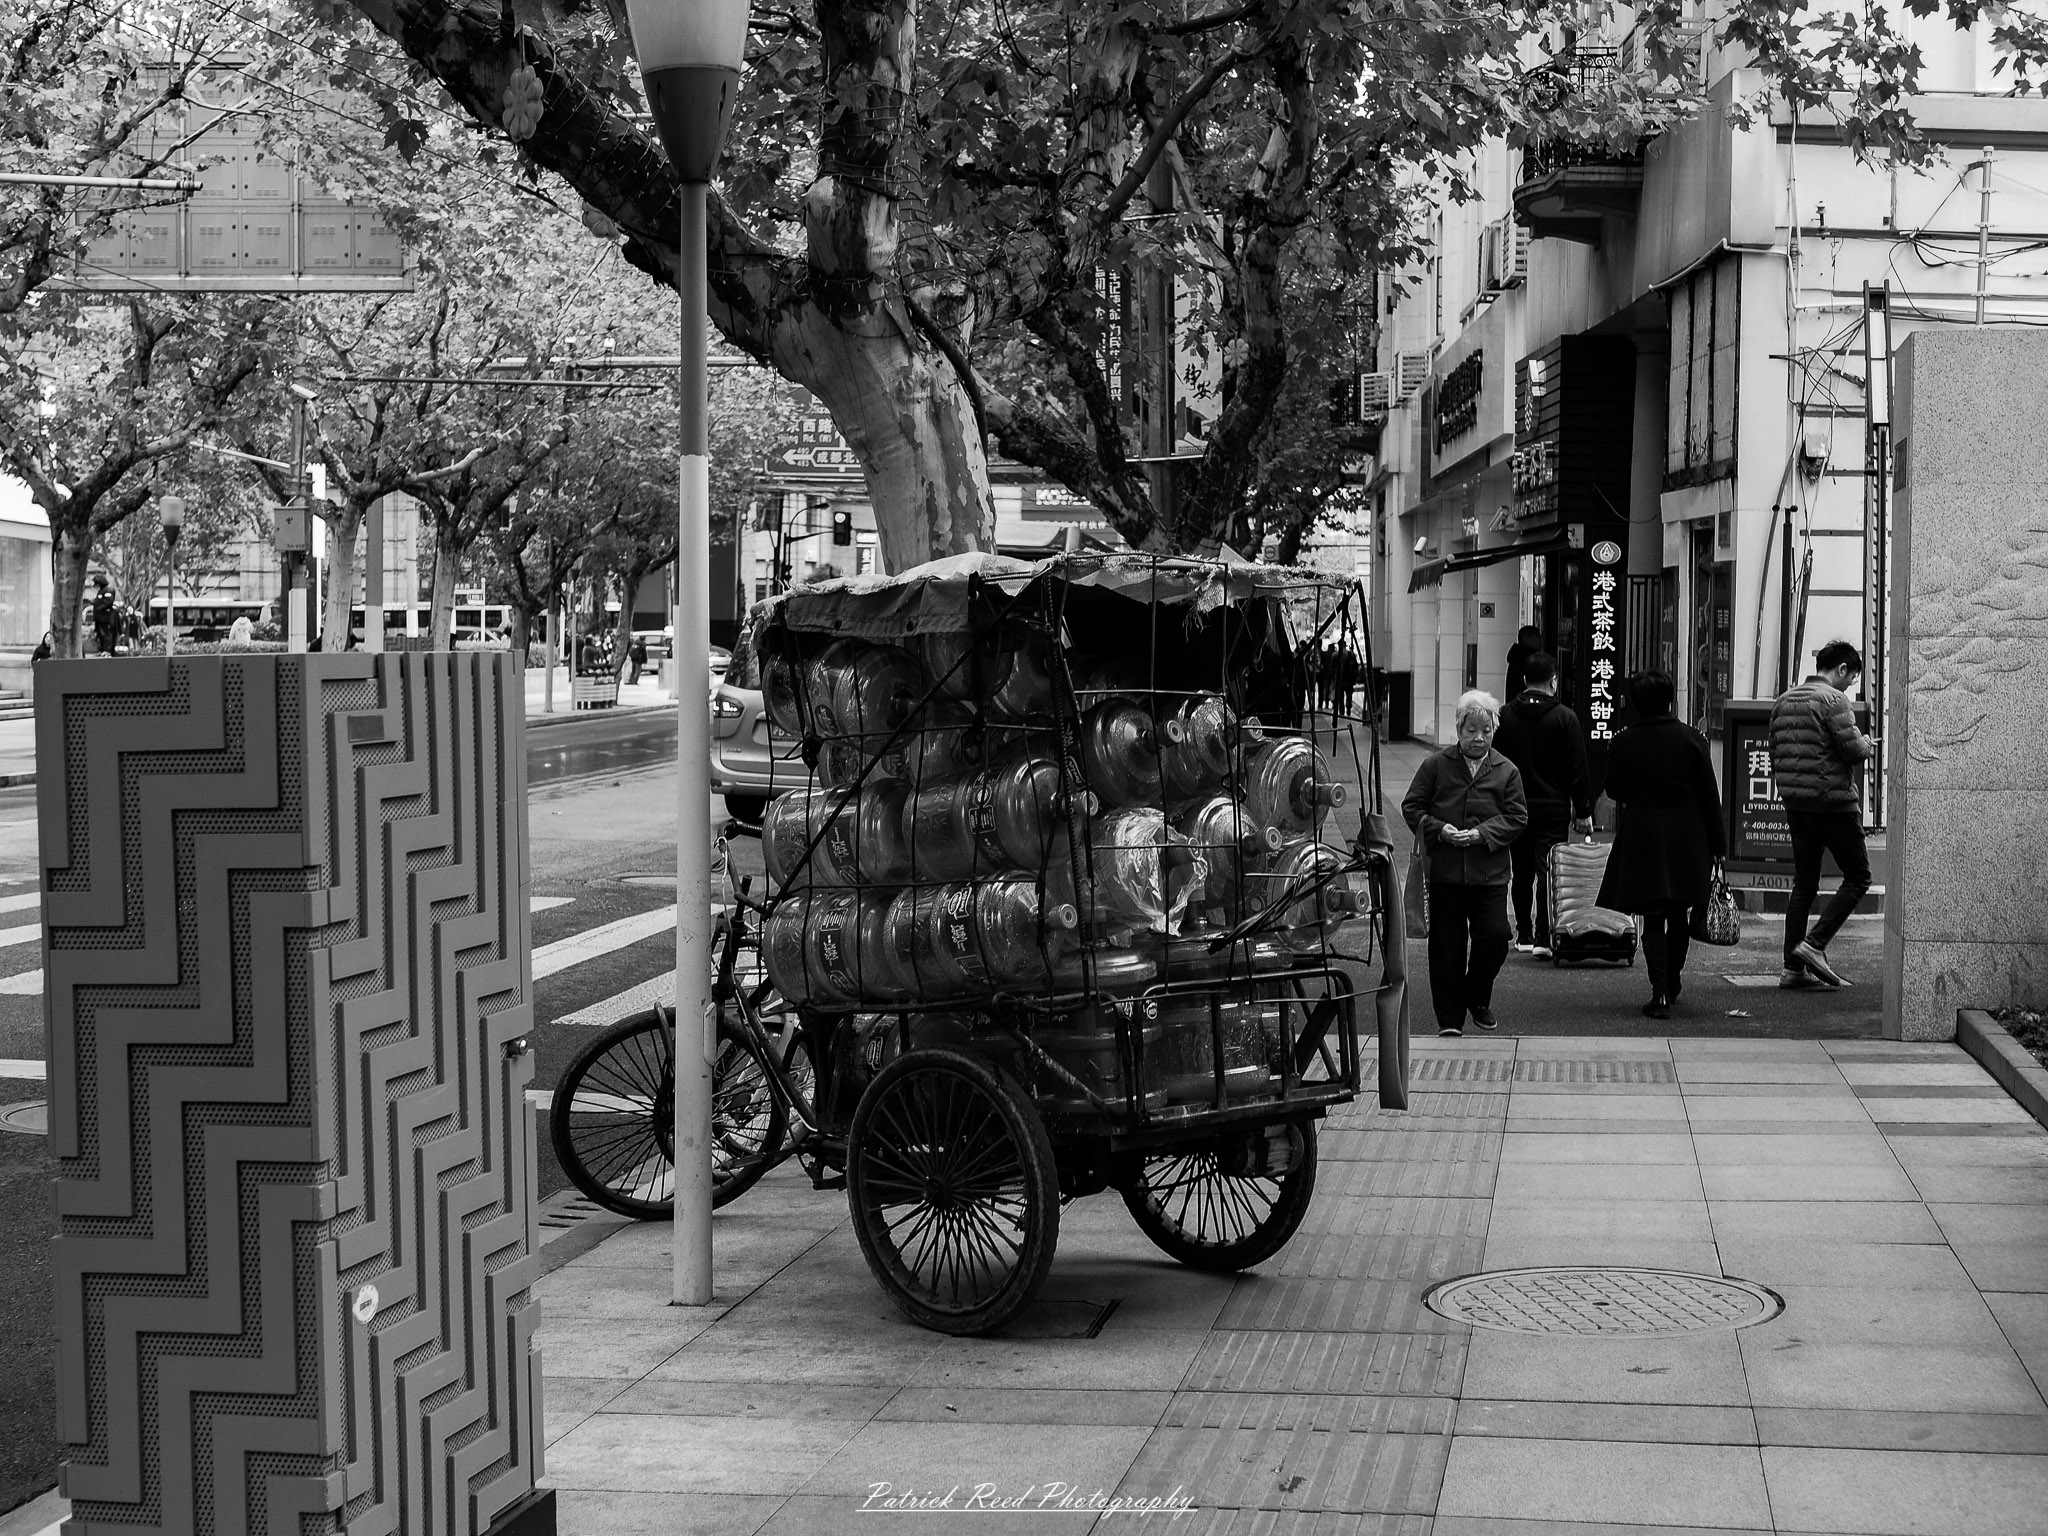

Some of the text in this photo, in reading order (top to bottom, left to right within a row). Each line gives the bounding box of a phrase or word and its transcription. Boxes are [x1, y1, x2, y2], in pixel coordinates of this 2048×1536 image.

[817, 451, 859, 464] 成都北
[1590, 570, 1616, 739] 港式茶飲 港式甜品
[1748, 750, 1772, 776] 拜
[1749, 777, 1782, 801] 口
[1748, 803, 1786, 811] BYBO DEN
[1752, 821, 1790, 831] 400-003-0
[1748, 875, 1790, 888] JA001
